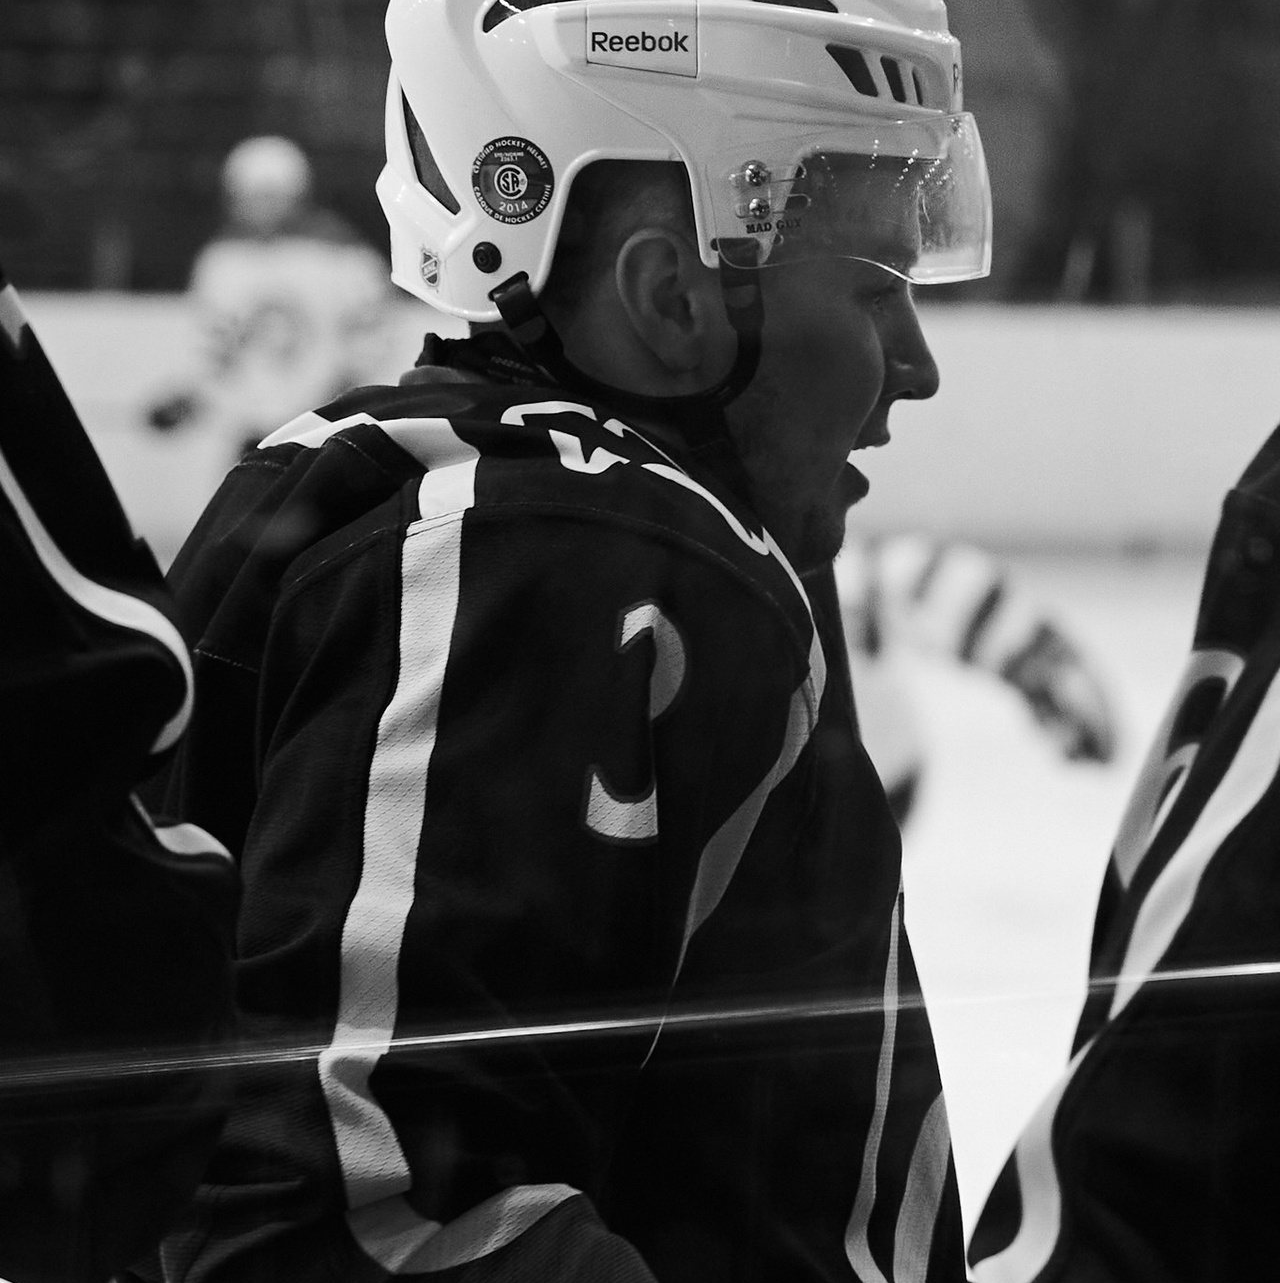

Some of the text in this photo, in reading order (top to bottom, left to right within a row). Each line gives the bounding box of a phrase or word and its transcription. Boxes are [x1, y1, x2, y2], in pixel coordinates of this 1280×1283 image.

[591, 31, 689, 52] Reebok
[495, 139, 525, 149] HOCKEY
[527, 146, 548, 169] HELMET
[473, 186, 494, 215] CASQUE
[494, 213, 503, 221] DE
[505, 211, 535, 224] HOCKEY
[499, 200, 528, 213] 2014
[746, 222, 772, 234] MAD
